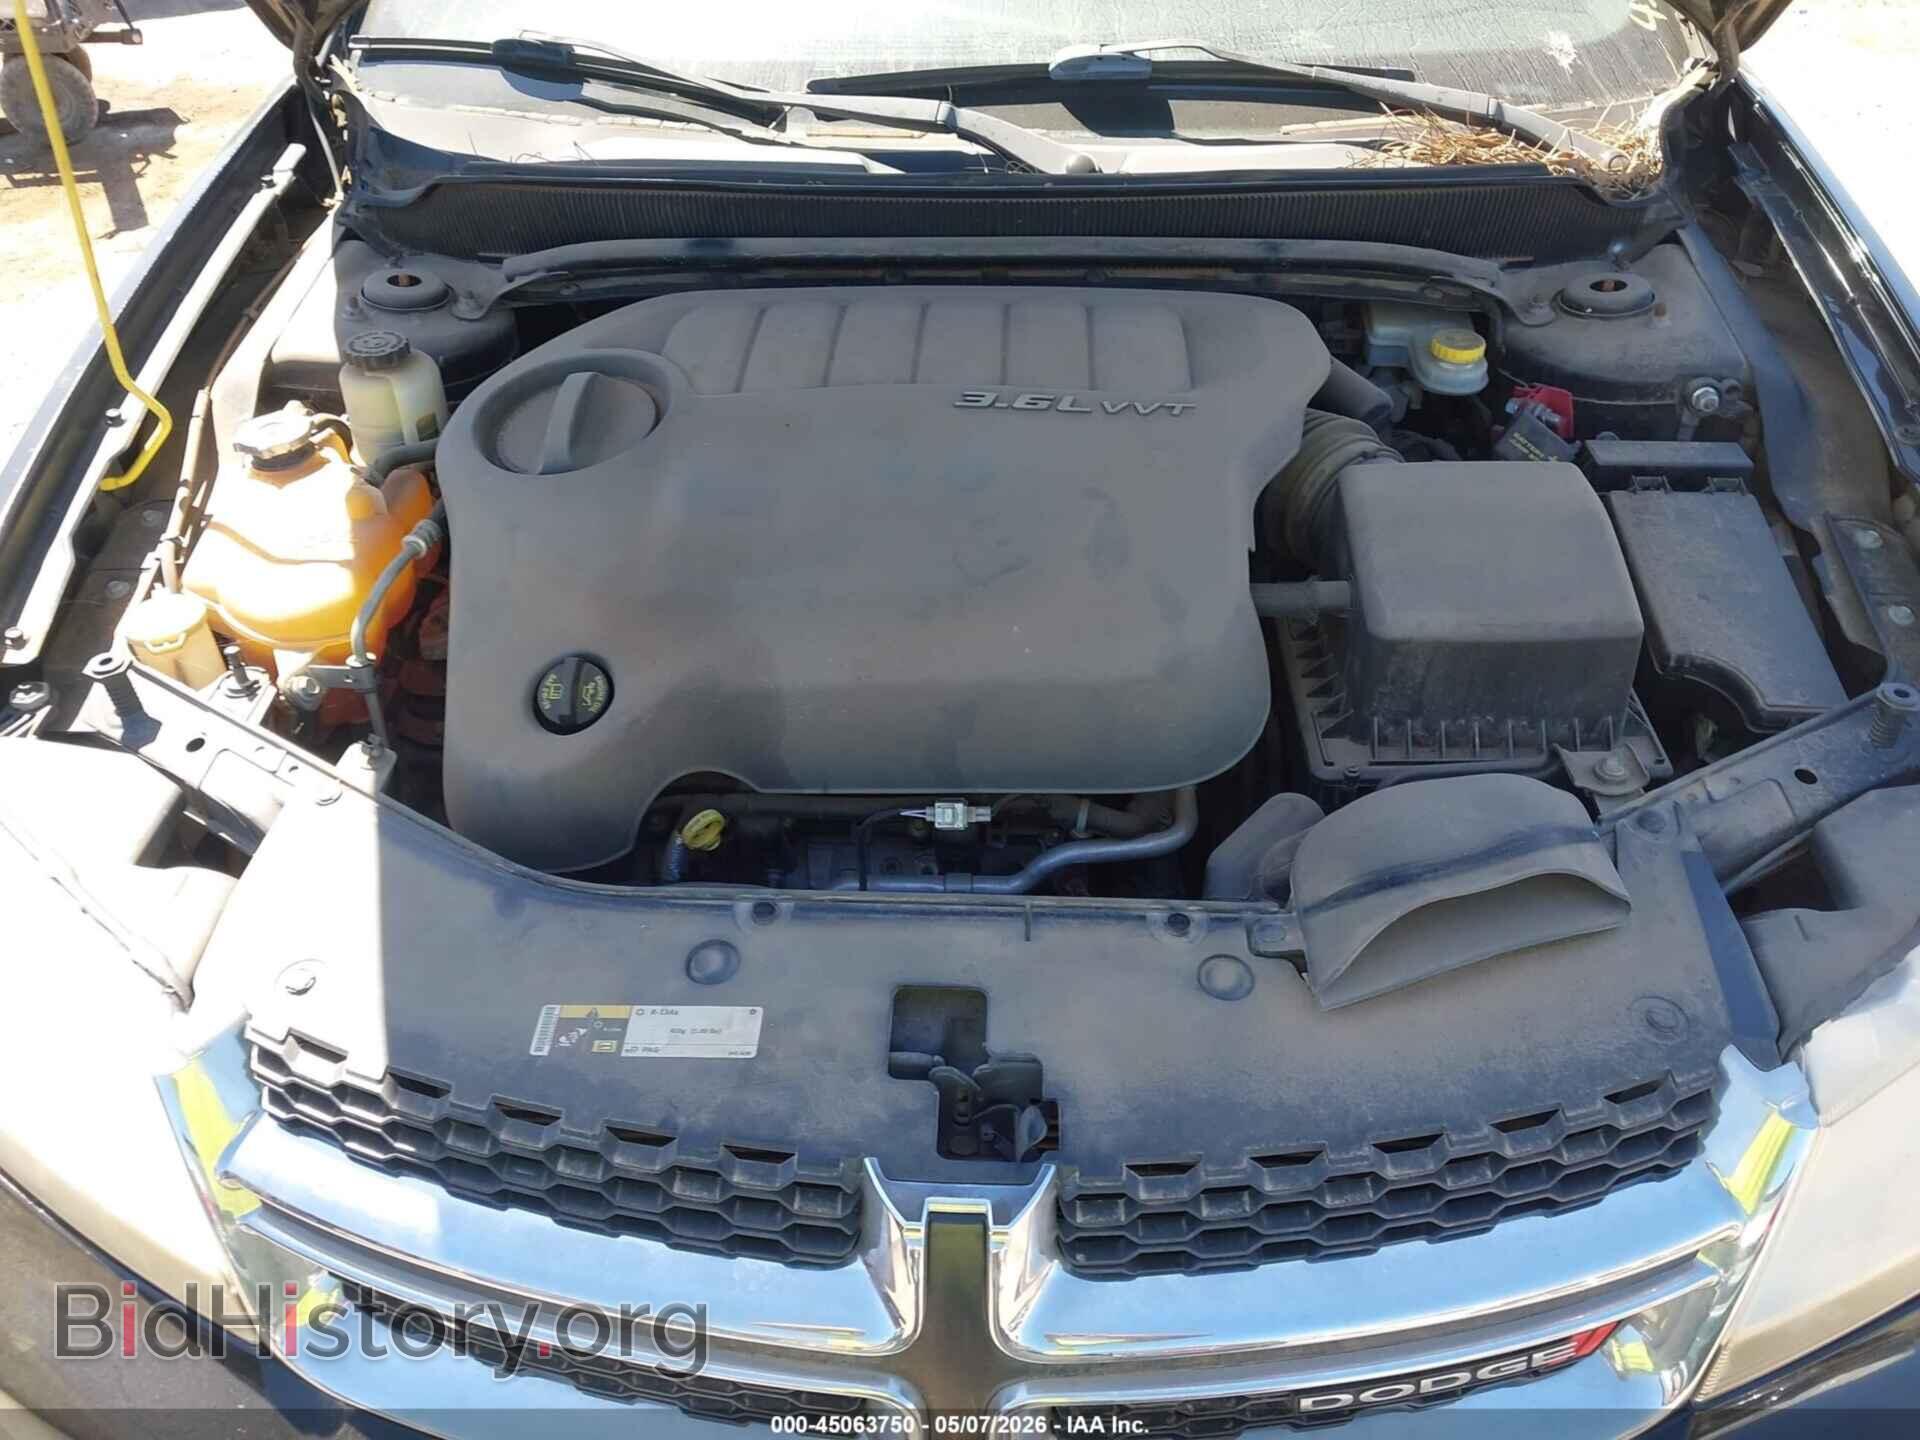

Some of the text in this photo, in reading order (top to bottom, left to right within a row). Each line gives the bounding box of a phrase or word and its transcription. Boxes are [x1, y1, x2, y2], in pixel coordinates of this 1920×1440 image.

[953, 391, 1197, 416] 3.6L VVT
[1299, 1340, 1578, 1411] DODGE
